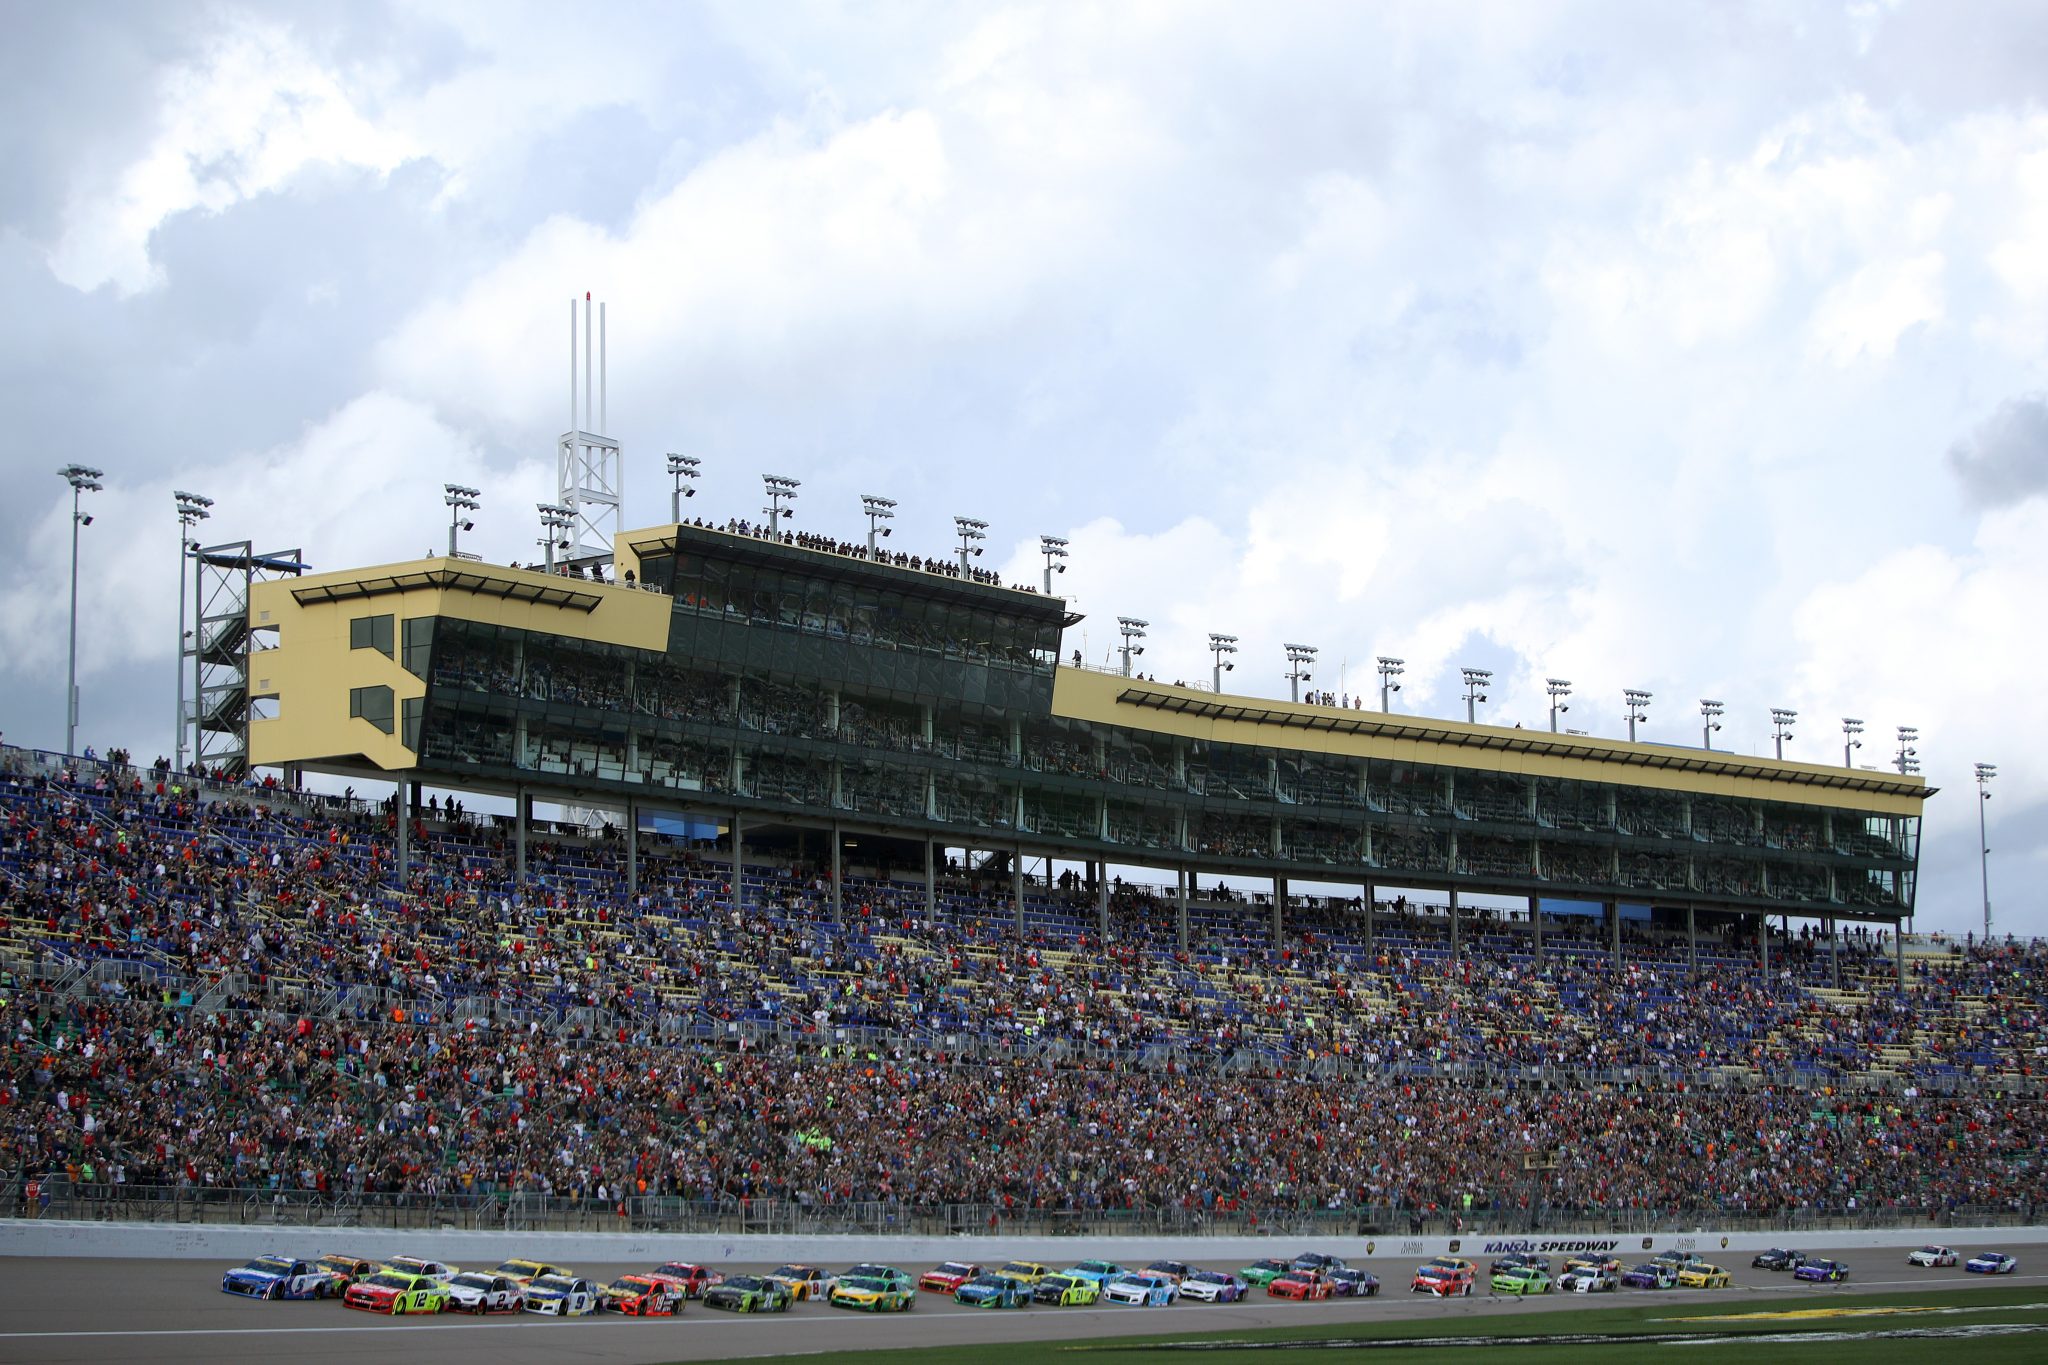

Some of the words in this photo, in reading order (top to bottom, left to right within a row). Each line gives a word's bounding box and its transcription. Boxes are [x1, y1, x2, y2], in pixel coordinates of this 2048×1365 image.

[1483, 1240, 1536, 1253] KANSAS
[1538, 1241, 1619, 1252] SPEEDWAY
[812, 1282, 819, 1295] 8
[413, 1292, 427, 1308] 12
[495, 1293, 507, 1309] 2
[574, 1295, 586, 1309] 9
[654, 1294, 665, 1312] 19
